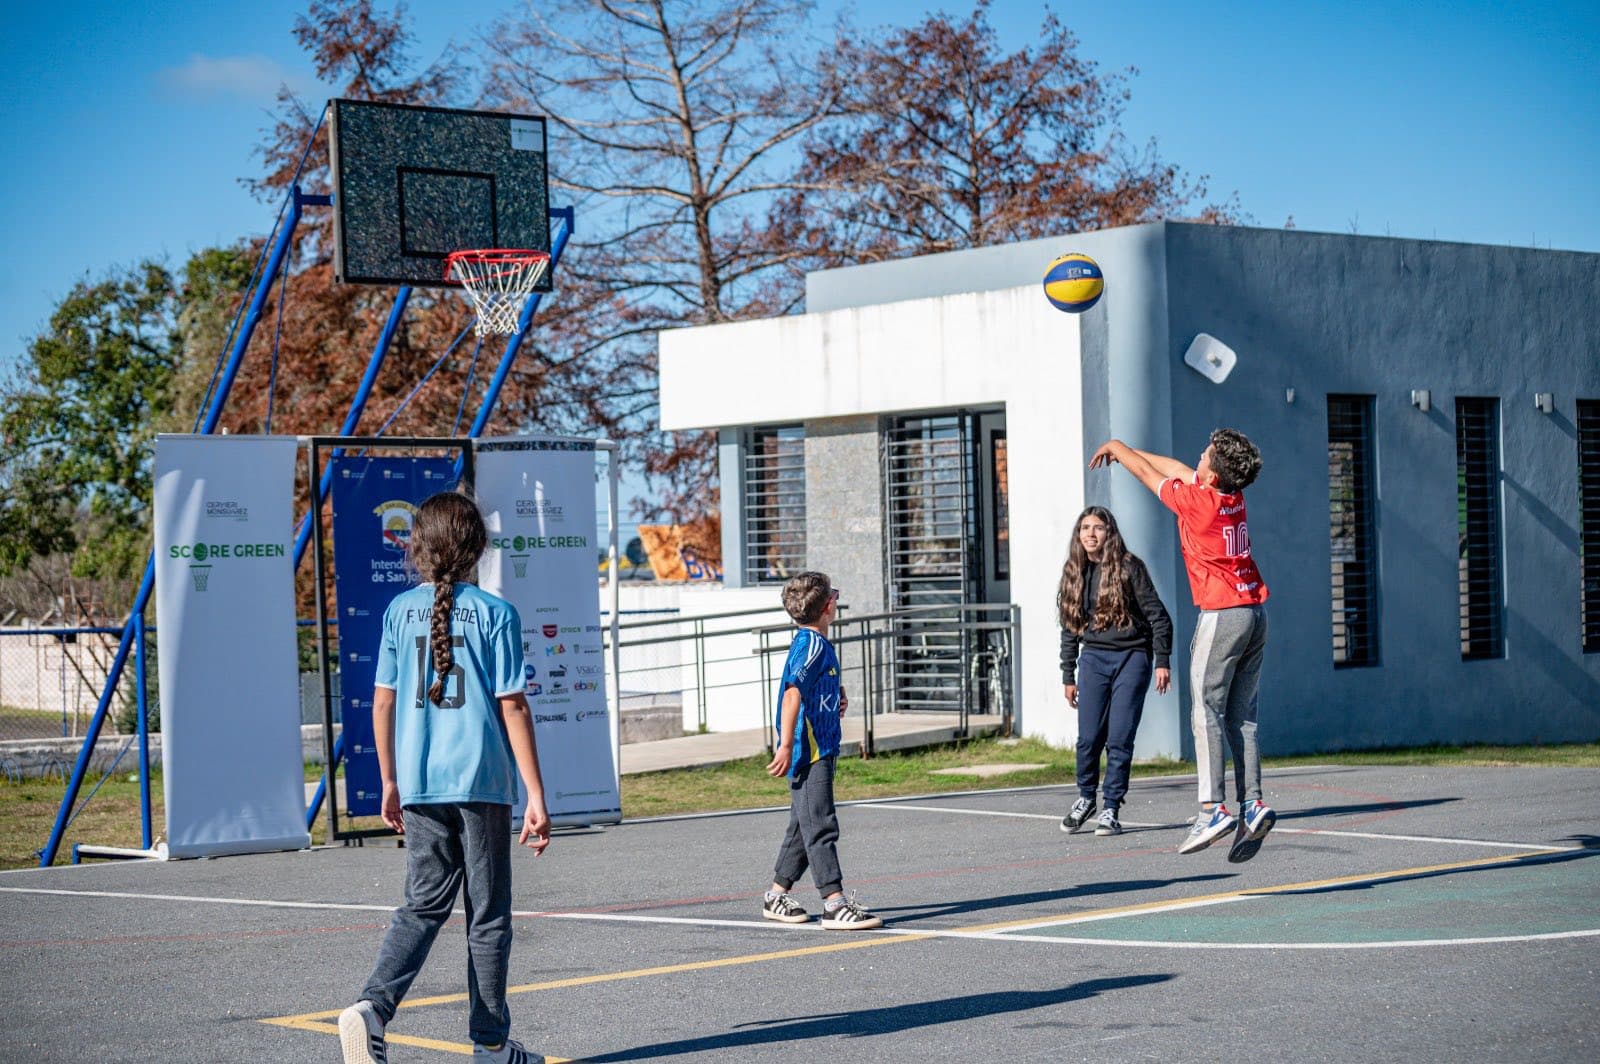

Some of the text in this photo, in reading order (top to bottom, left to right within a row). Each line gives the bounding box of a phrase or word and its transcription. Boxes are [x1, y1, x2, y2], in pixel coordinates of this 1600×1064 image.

[549, 536, 587, 548] GREEN
[1222, 521, 1251, 557] 10
[233, 543, 285, 558] GREEN
[371, 570, 385, 583] de
[386, 570, 406, 583] San
[418, 607, 477, 625] VARDE
[574, 680, 598, 691] ebay
[535, 712, 567, 724] SPALDING
